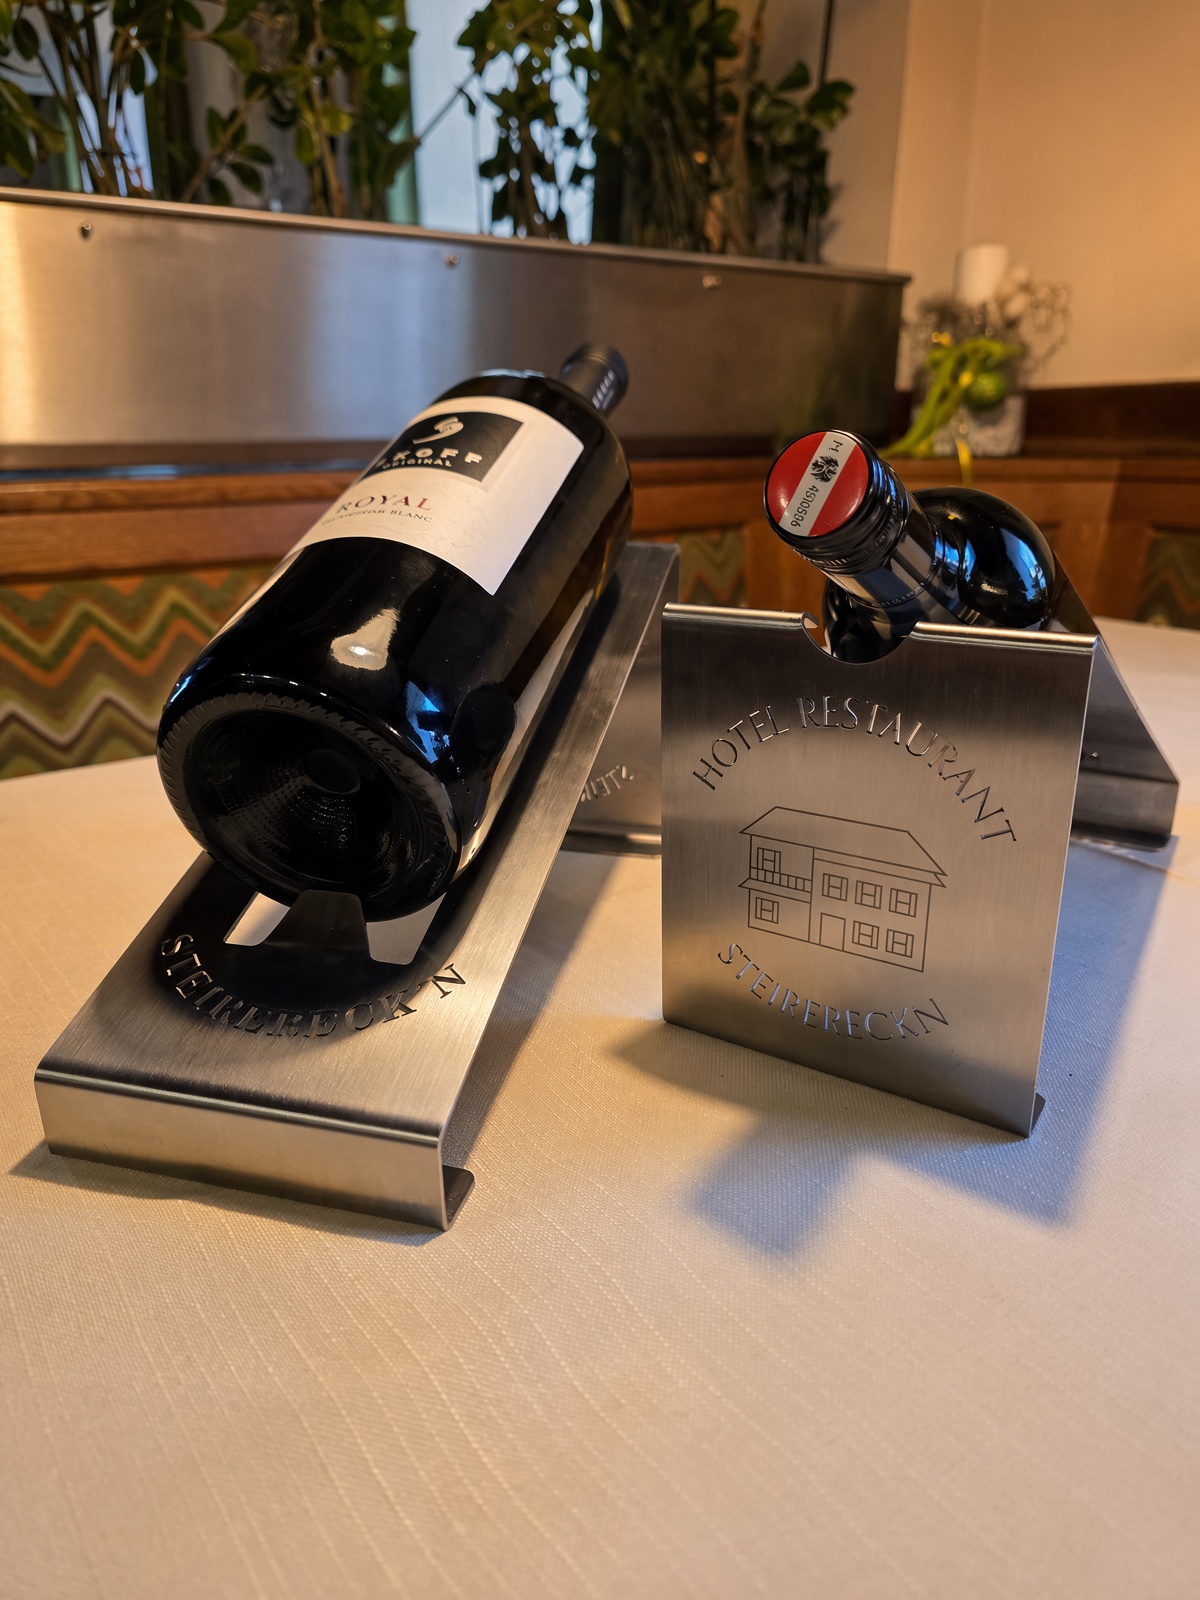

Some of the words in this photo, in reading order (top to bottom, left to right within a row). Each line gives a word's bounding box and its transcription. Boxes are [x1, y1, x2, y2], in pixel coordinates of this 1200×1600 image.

[381, 458, 452, 470] ORIGINAL
[336, 494, 432, 514] ROYAL
[389, 510, 433, 523] BLANC
[692, 705, 789, 791] HOTEL
[797, 695, 1017, 842] RESTAURANT
